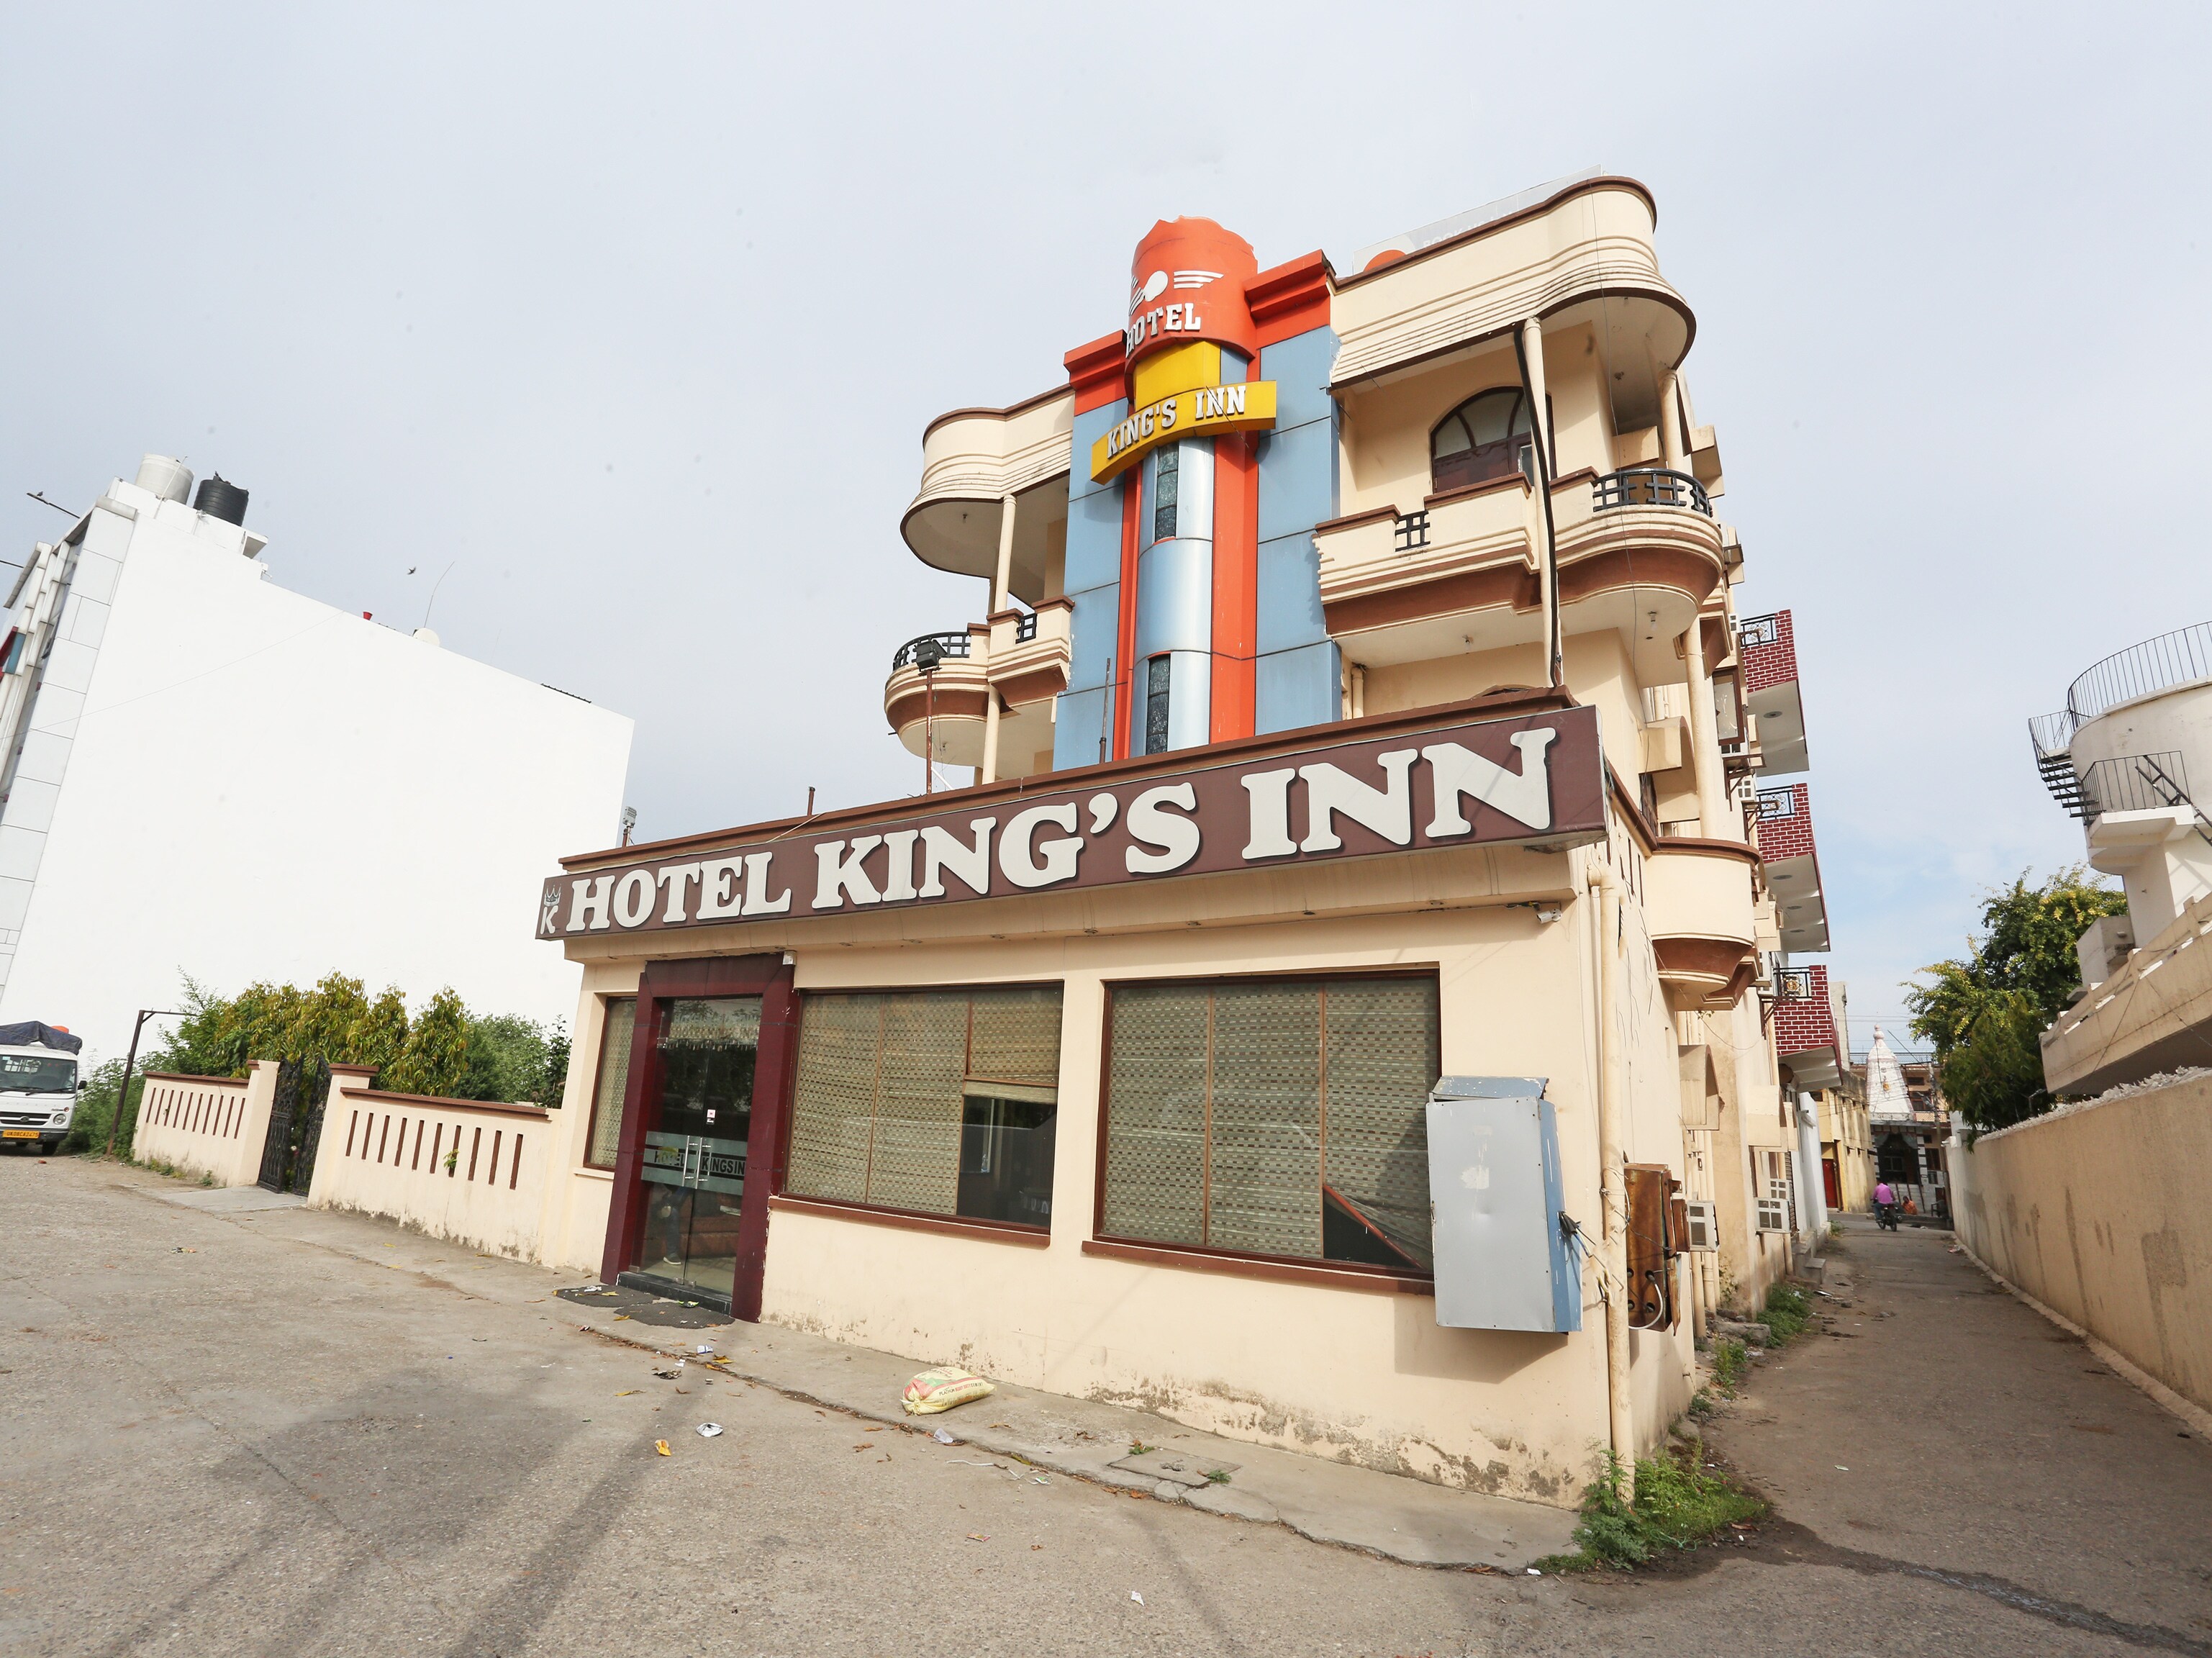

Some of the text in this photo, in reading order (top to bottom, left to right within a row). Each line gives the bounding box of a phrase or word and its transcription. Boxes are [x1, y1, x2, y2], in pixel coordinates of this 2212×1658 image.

[1125, 303, 1201, 358] HOTEL
[1106, 385, 1246, 459] KING'S INN
[566, 727, 1557, 933] HOTEL KING'S INN
[540, 905, 558, 935] K
